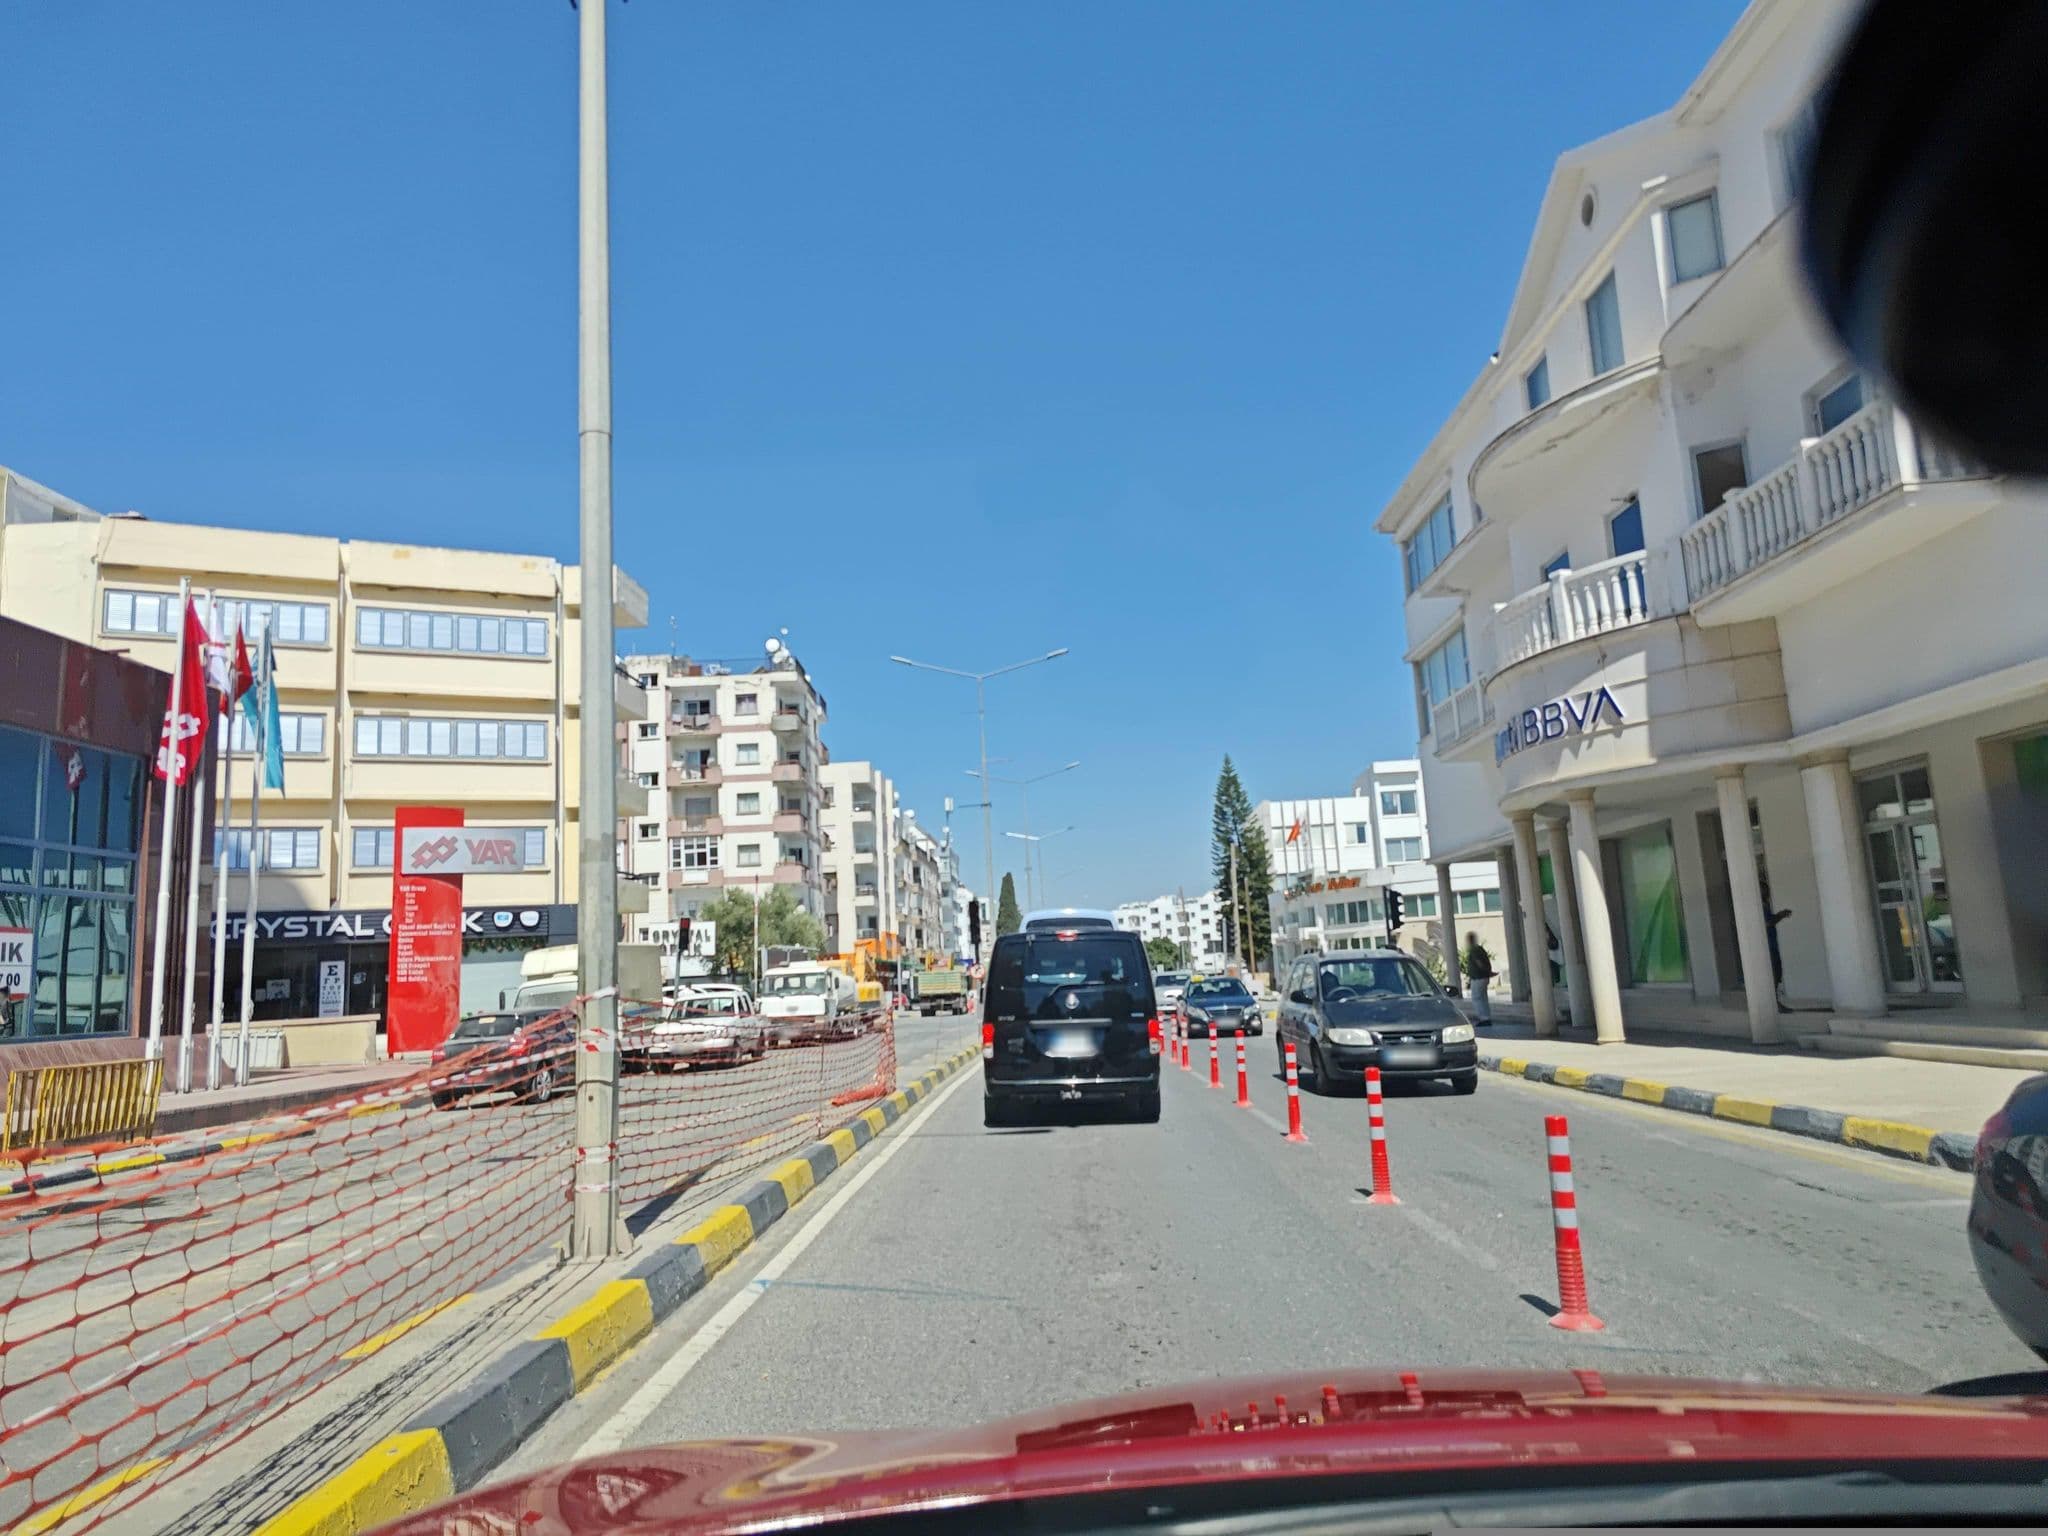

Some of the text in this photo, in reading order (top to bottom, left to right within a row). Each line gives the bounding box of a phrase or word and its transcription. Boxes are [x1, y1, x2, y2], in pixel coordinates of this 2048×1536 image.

[1522, 684, 1625, 746] BBVA
[465, 839, 518, 865] YAR
[328, 965, 338, 976] E
